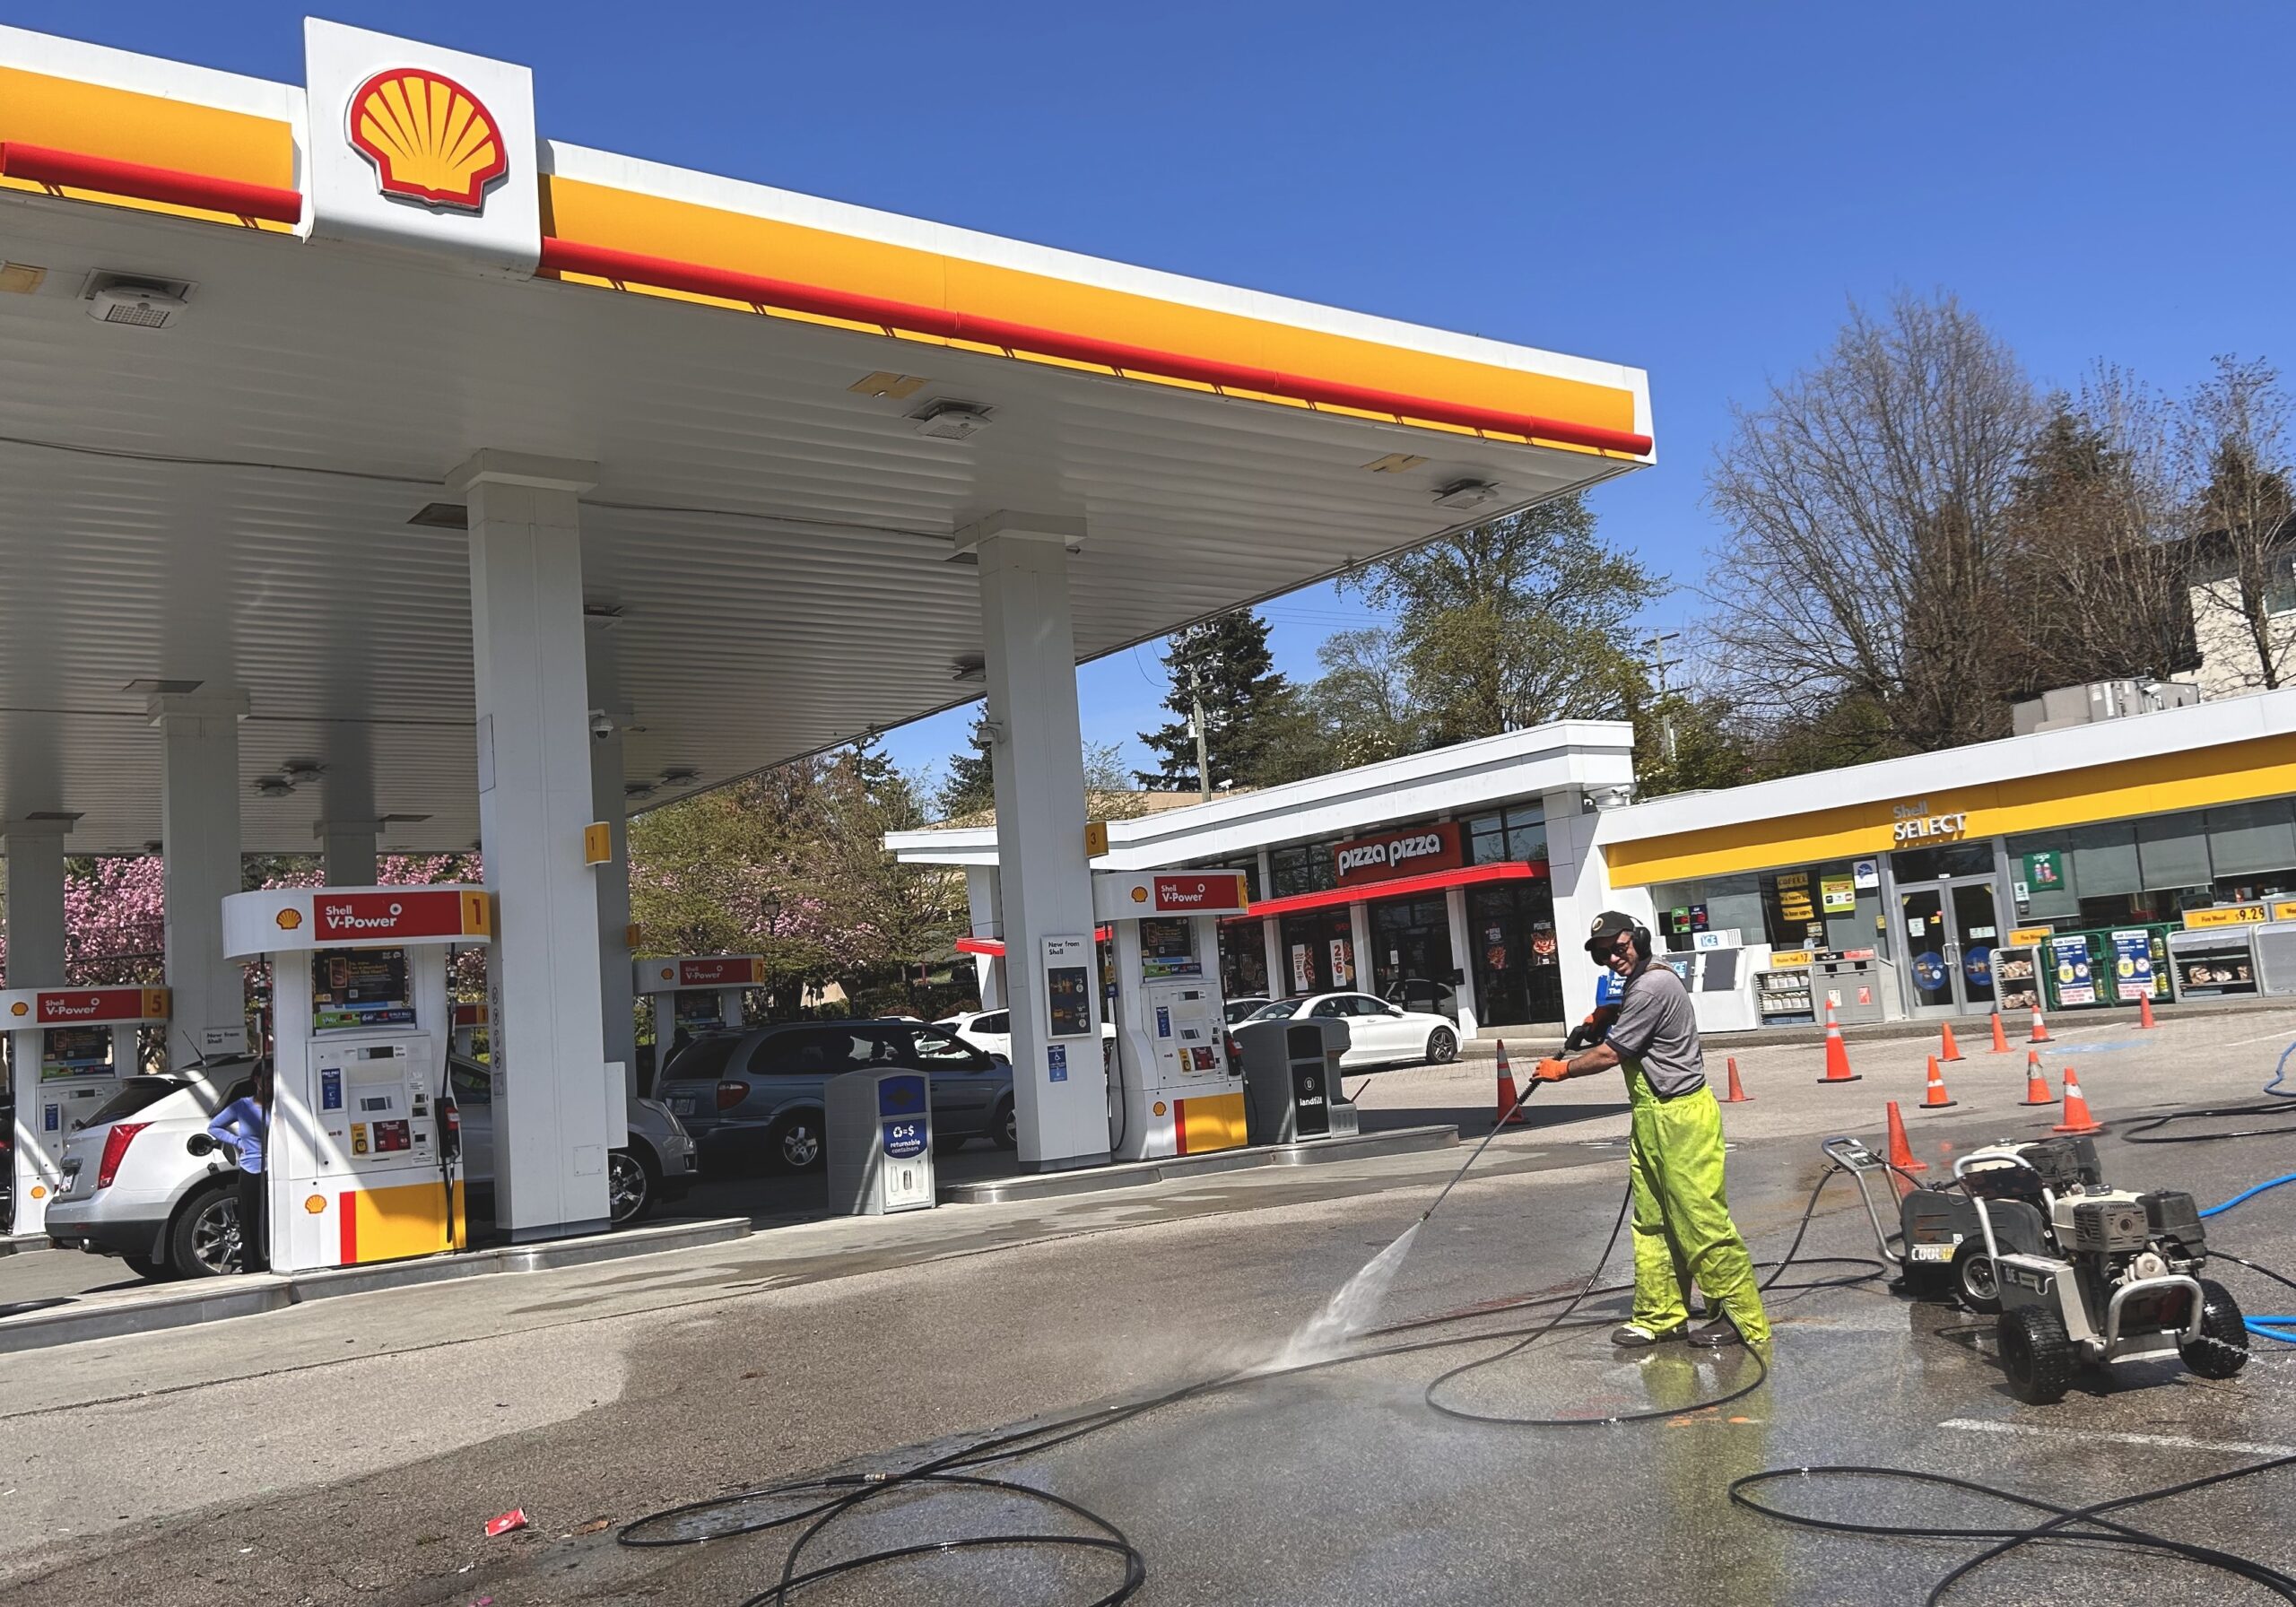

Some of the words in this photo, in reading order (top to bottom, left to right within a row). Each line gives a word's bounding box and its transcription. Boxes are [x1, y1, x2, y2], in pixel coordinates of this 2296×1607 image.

[1893, 800, 1928, 819] Shell
[1893, 812, 1966, 841] SELECT
[1090, 832, 1097, 845] 3
[1338, 844, 1387, 876] pizza
[1389, 833, 1440, 867] pizza
[1161, 884, 1177, 892] Shell
[1162, 893, 1204, 903] V-Power
[326, 904, 352, 916] Shell
[472, 899, 482, 925] 1
[326, 916, 397, 929] V-Power
[1700, 934, 1718, 947] ICE
[1334, 944, 1341, 957] 2
[1674, 963, 1686, 973] CE
[45, 999, 65, 1007] Shell
[151, 995, 161, 1012] 5
[46, 1006, 97, 1016] V-Power
[1299, 1096, 1323, 1107] landfill
[890, 1139, 921, 1149] returnable
[891, 1146, 919, 1154] containers
